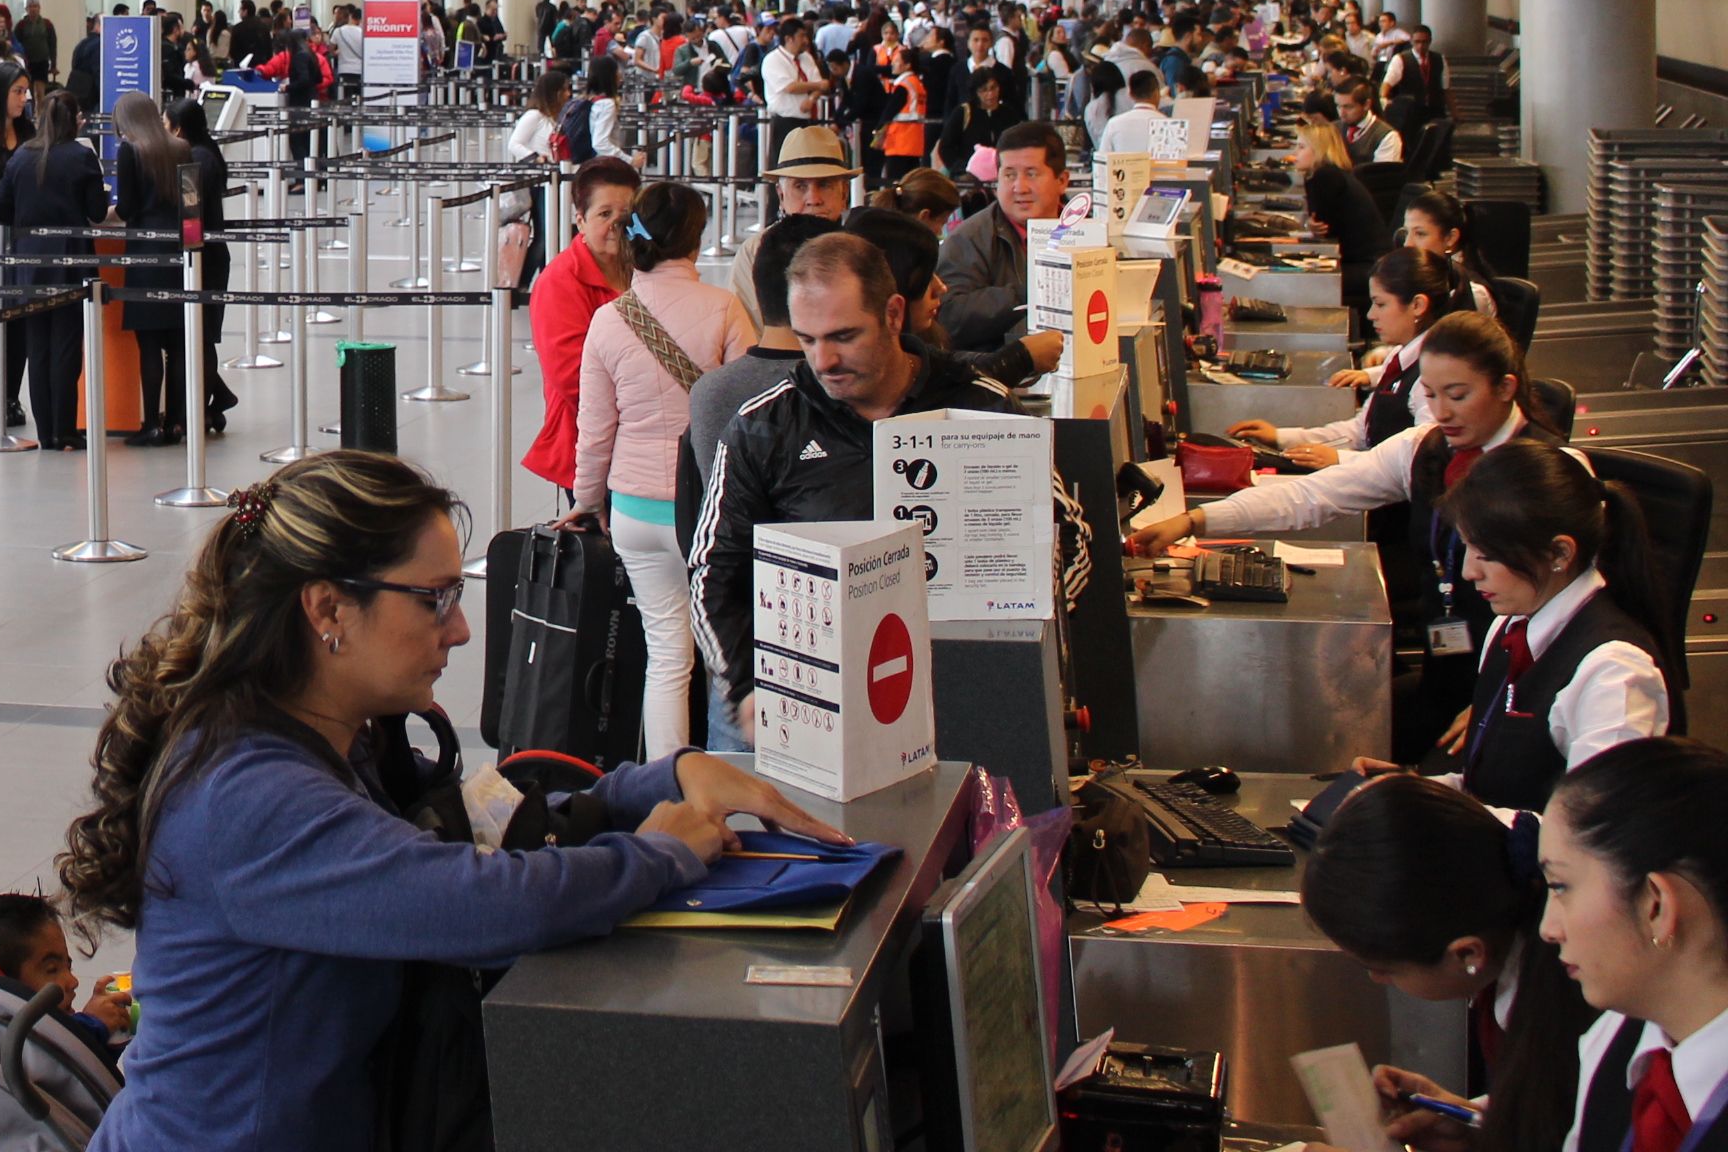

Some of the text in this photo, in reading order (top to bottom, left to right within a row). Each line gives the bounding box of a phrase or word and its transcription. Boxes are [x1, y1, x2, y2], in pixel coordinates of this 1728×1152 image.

[366, 17, 387, 25] SKY
[366, 24, 413, 33] PRIORITY
[1031, 227, 1052, 236] Posició
[892, 435, 934, 449] 3-1-1
[941, 434, 959, 442] para
[971, 433, 1005, 441] equipaje
[941, 441, 986, 450] for carry-ons
[800, 450, 828, 461] adidas
[896, 461, 904, 472] 3
[897, 508, 904, 519] 1
[848, 544, 910, 578] Posición Cerrada
[848, 569, 901, 600] Position Closed
[996, 602, 1036, 610] LATAM
[605, 609, 621, 660] ROWN
